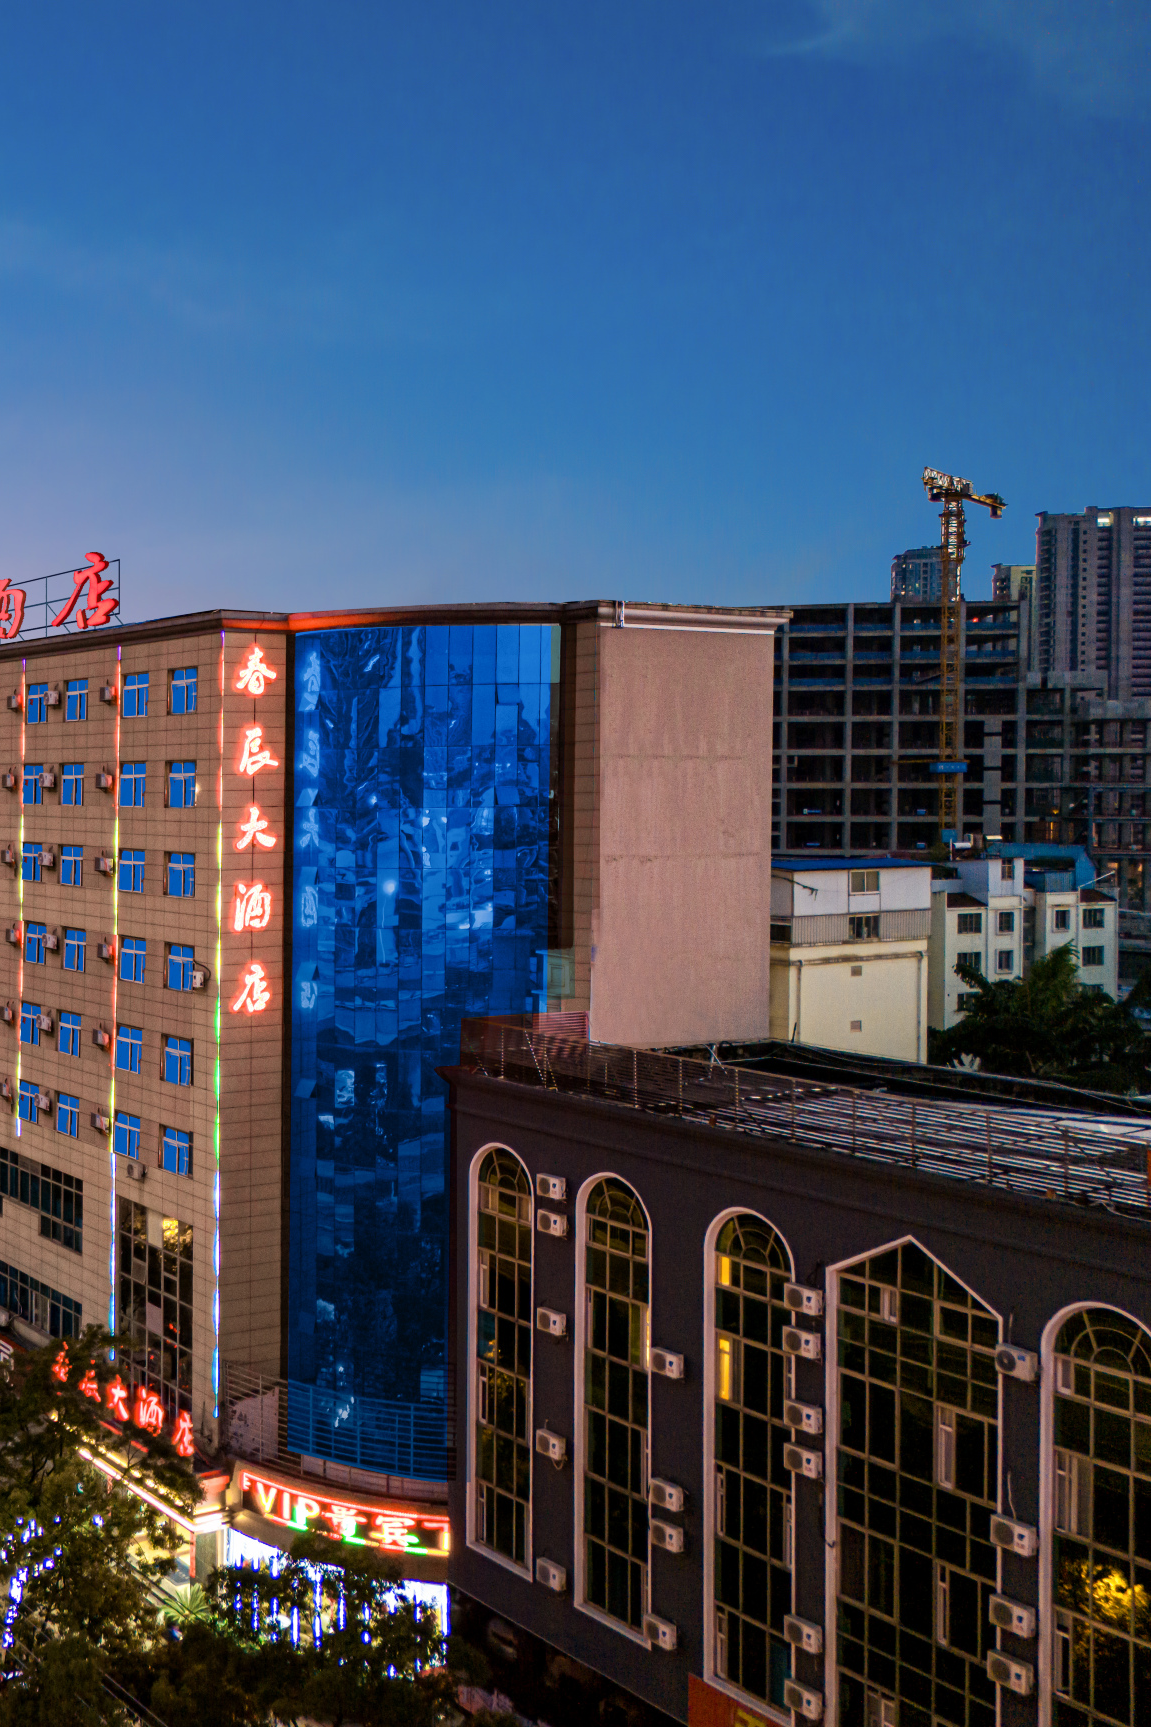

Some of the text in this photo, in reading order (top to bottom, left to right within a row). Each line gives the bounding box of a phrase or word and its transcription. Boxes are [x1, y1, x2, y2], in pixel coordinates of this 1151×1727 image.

[233, 647, 279, 1013] 春辰大酒店
